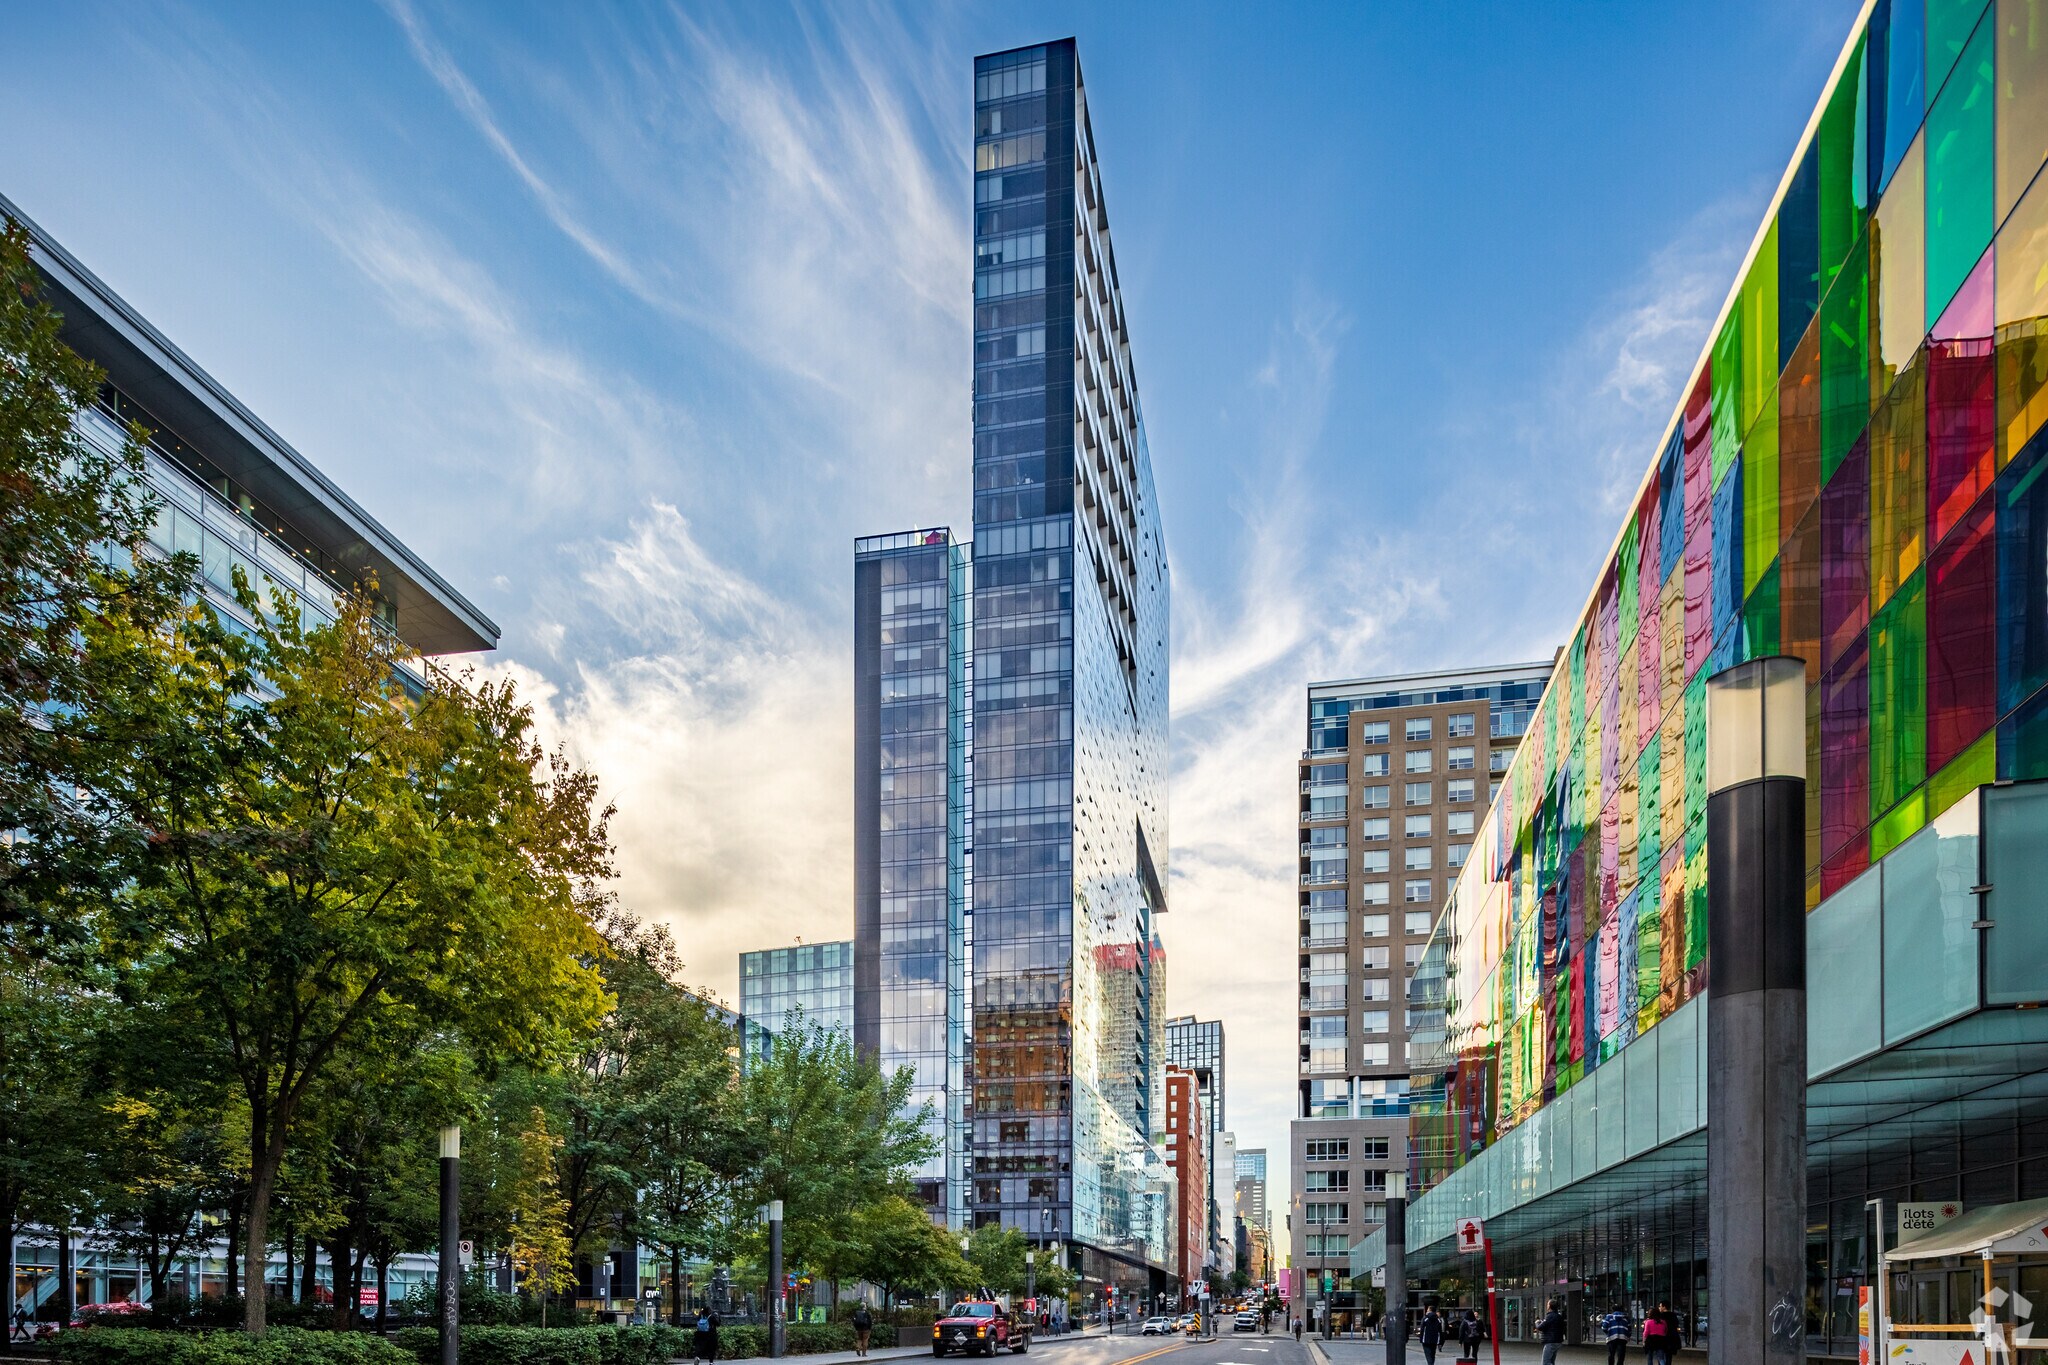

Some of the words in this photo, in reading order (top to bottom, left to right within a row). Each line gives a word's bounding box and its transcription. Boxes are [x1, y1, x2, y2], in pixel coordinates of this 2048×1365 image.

[1903, 1208, 1935, 1219] îlots
[1903, 1219, 1935, 1229] d'été
[1376, 1267, 1382, 1275] P
